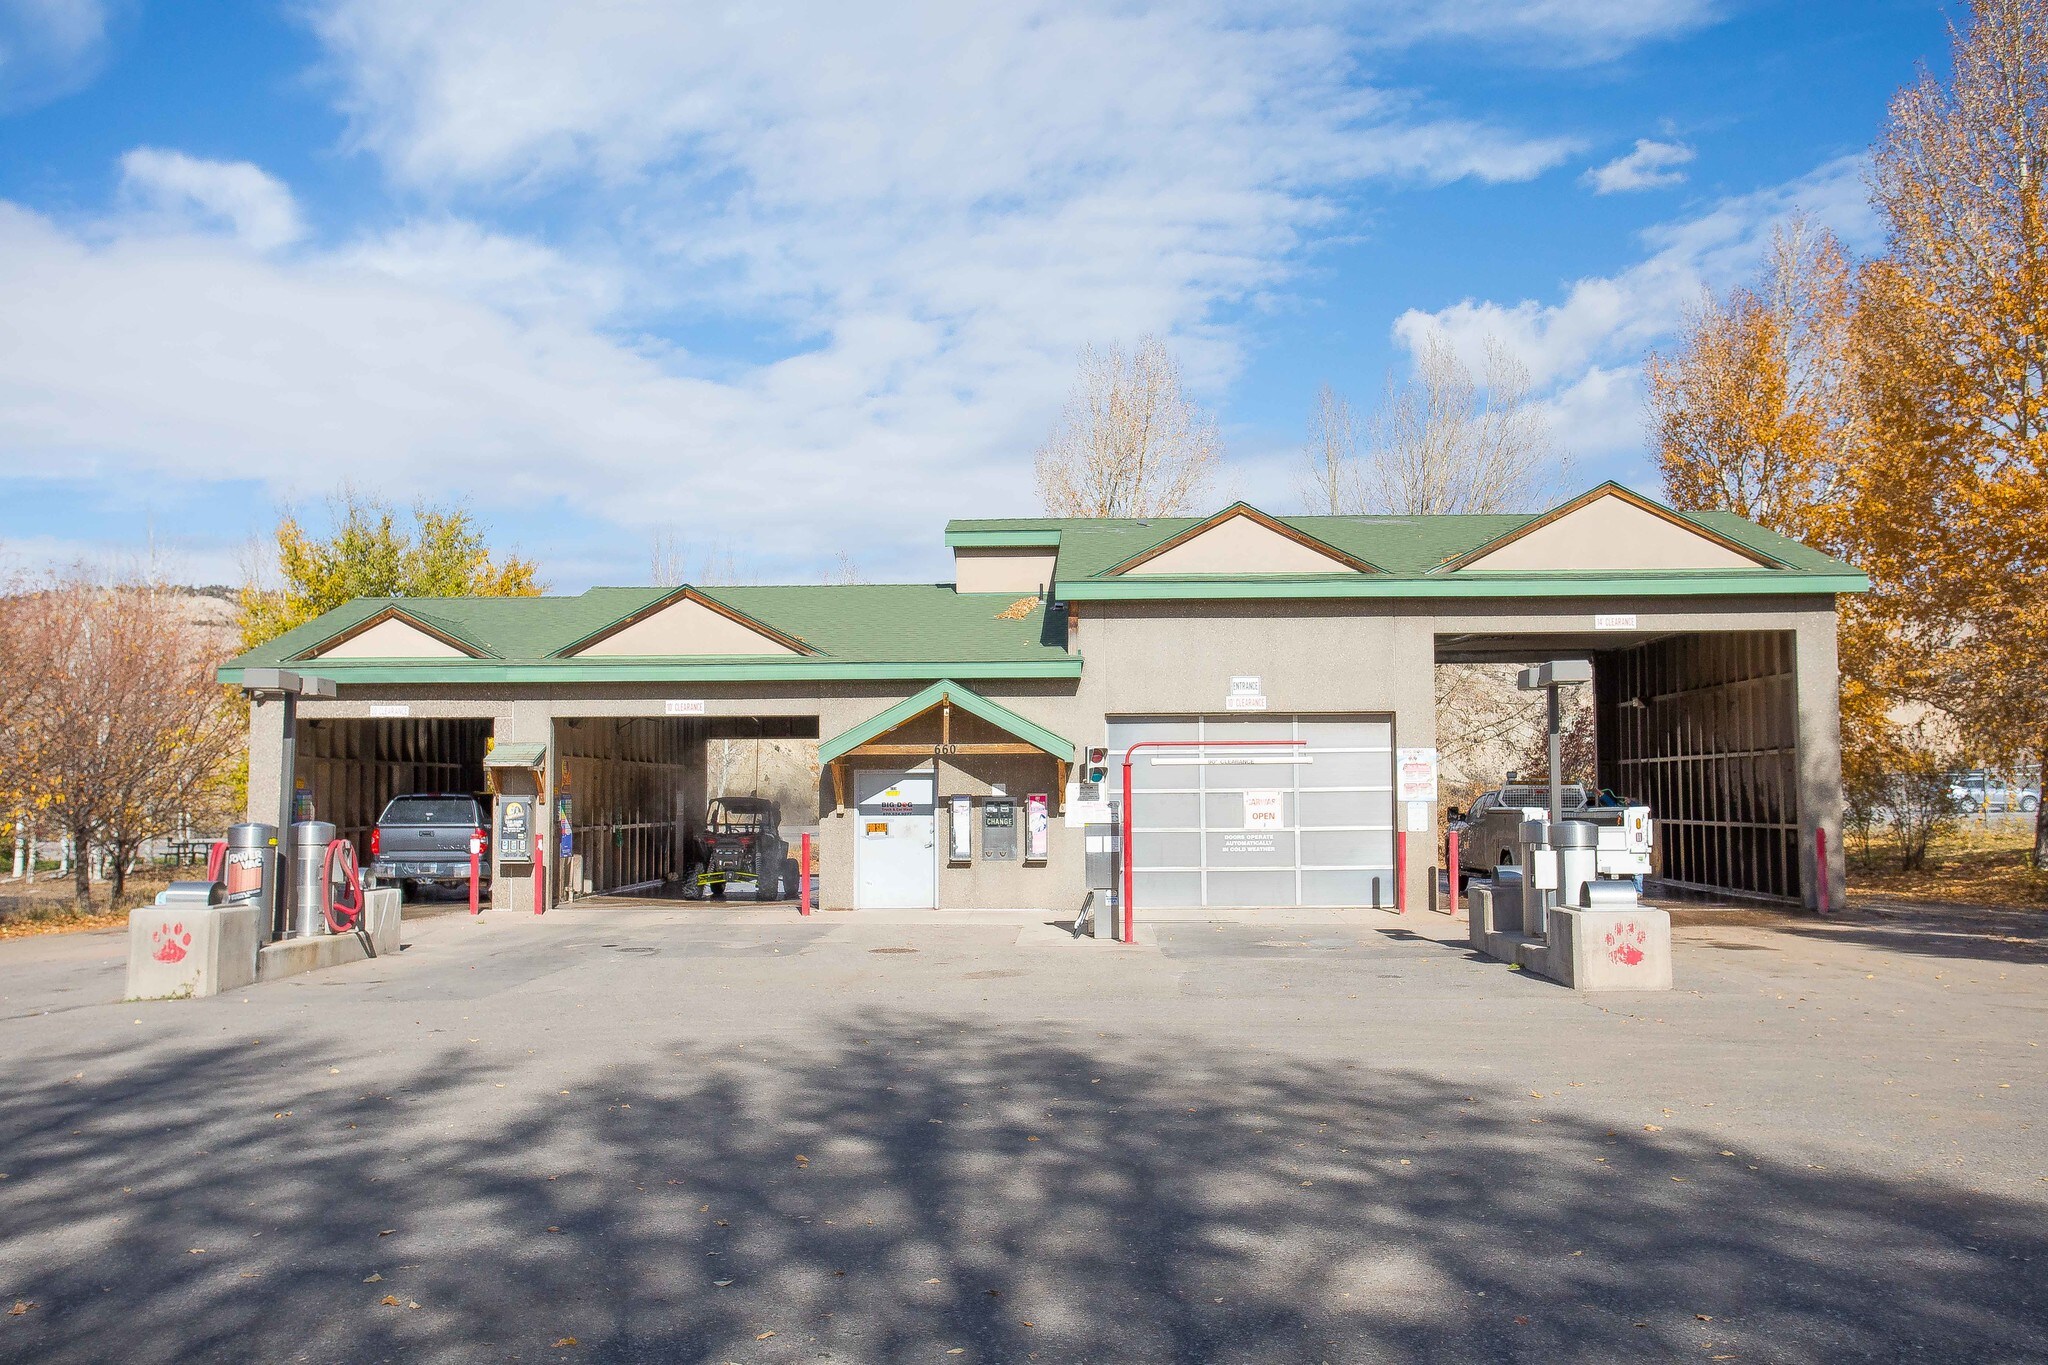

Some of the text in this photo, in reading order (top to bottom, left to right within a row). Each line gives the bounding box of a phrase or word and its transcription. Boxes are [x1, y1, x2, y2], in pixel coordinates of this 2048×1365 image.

[1605, 617, 1635, 627] CLEARANCE
[1232, 681, 1259, 691] ENTRANCE
[675, 702, 703, 712] CLEARANCE
[1235, 698, 1265, 708] CLEARANCE
[934, 744, 956, 755] 660
[1252, 812, 1275, 820] OPEN
[986, 818, 1013, 826] CHANGE
[876, 823, 887, 833] SALE
[229, 849, 263, 864] POWER
[240, 858, 262, 870] VAC
